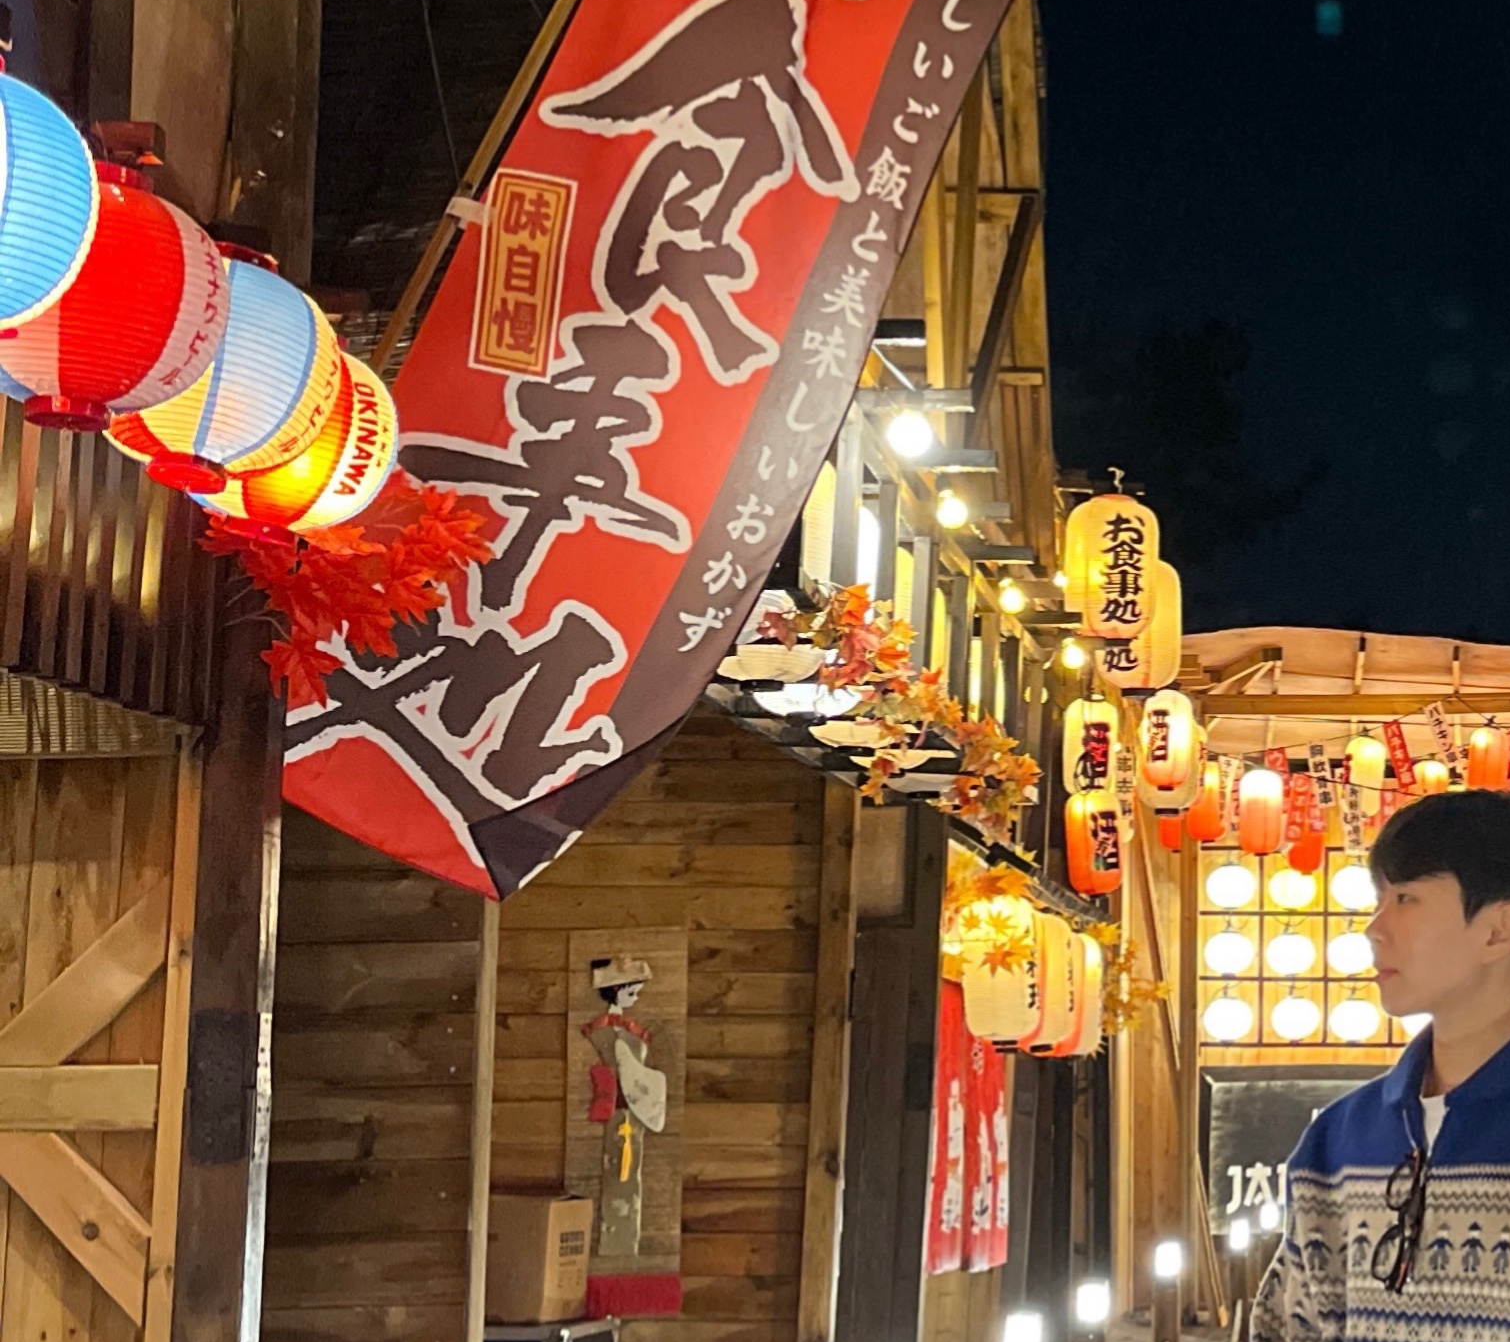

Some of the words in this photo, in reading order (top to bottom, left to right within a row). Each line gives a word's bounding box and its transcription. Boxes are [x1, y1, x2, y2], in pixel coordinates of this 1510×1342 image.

[497, 190, 558, 360] 味自慢
[333, 382, 380, 497] OKINAWA
[1100, 513, 1146, 625] お食事処
